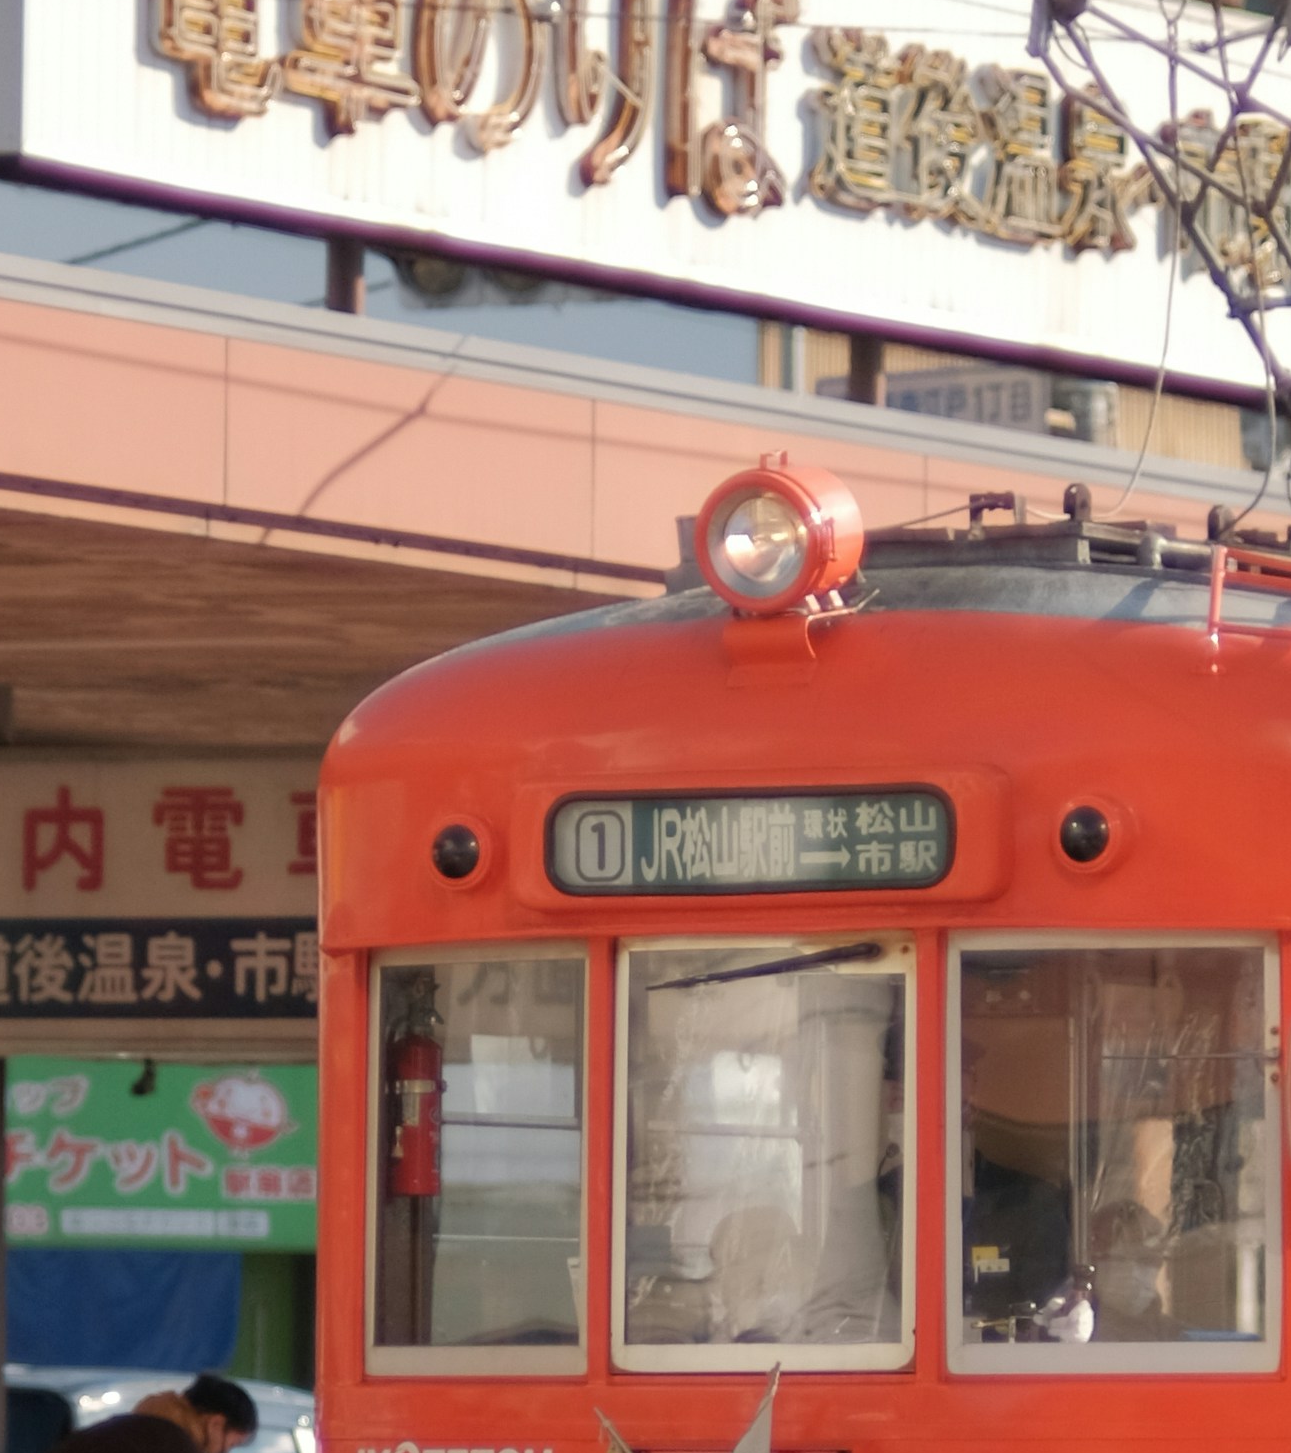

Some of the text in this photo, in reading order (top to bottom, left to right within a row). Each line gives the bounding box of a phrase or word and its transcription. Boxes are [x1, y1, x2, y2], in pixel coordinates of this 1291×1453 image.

[804, 808, 849, 840] 環状
[855, 800, 938, 836] 松山
[590, 821, 608, 872] 1
[640, 803, 796, 882] JR松山駅前
[855, 840, 939, 875] 市駅
